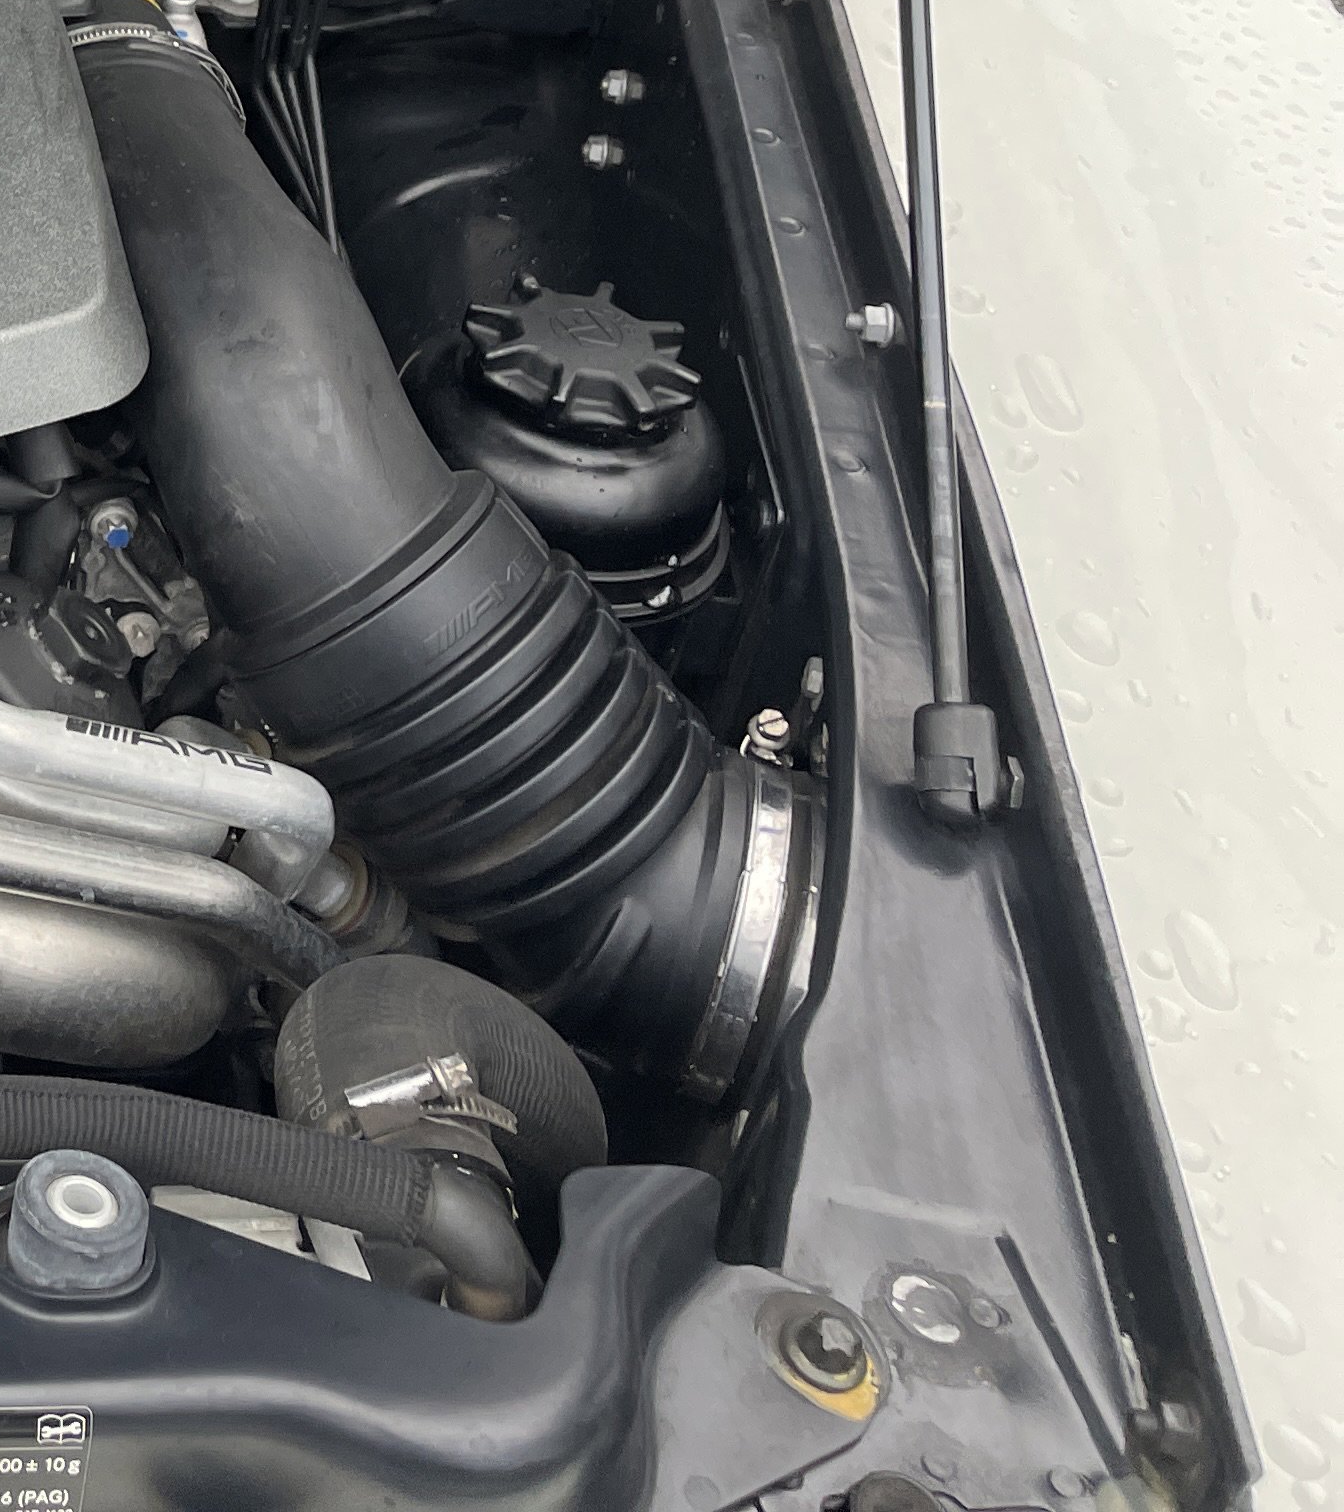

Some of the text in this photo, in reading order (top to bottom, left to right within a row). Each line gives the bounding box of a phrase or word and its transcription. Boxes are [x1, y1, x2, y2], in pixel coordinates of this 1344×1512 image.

[129, 730, 273, 776] AMG
[44, 1456, 65, 1473] 10
[67, 1459, 82, 1475] g
[17, 1489, 70, 1507] (PAG)
